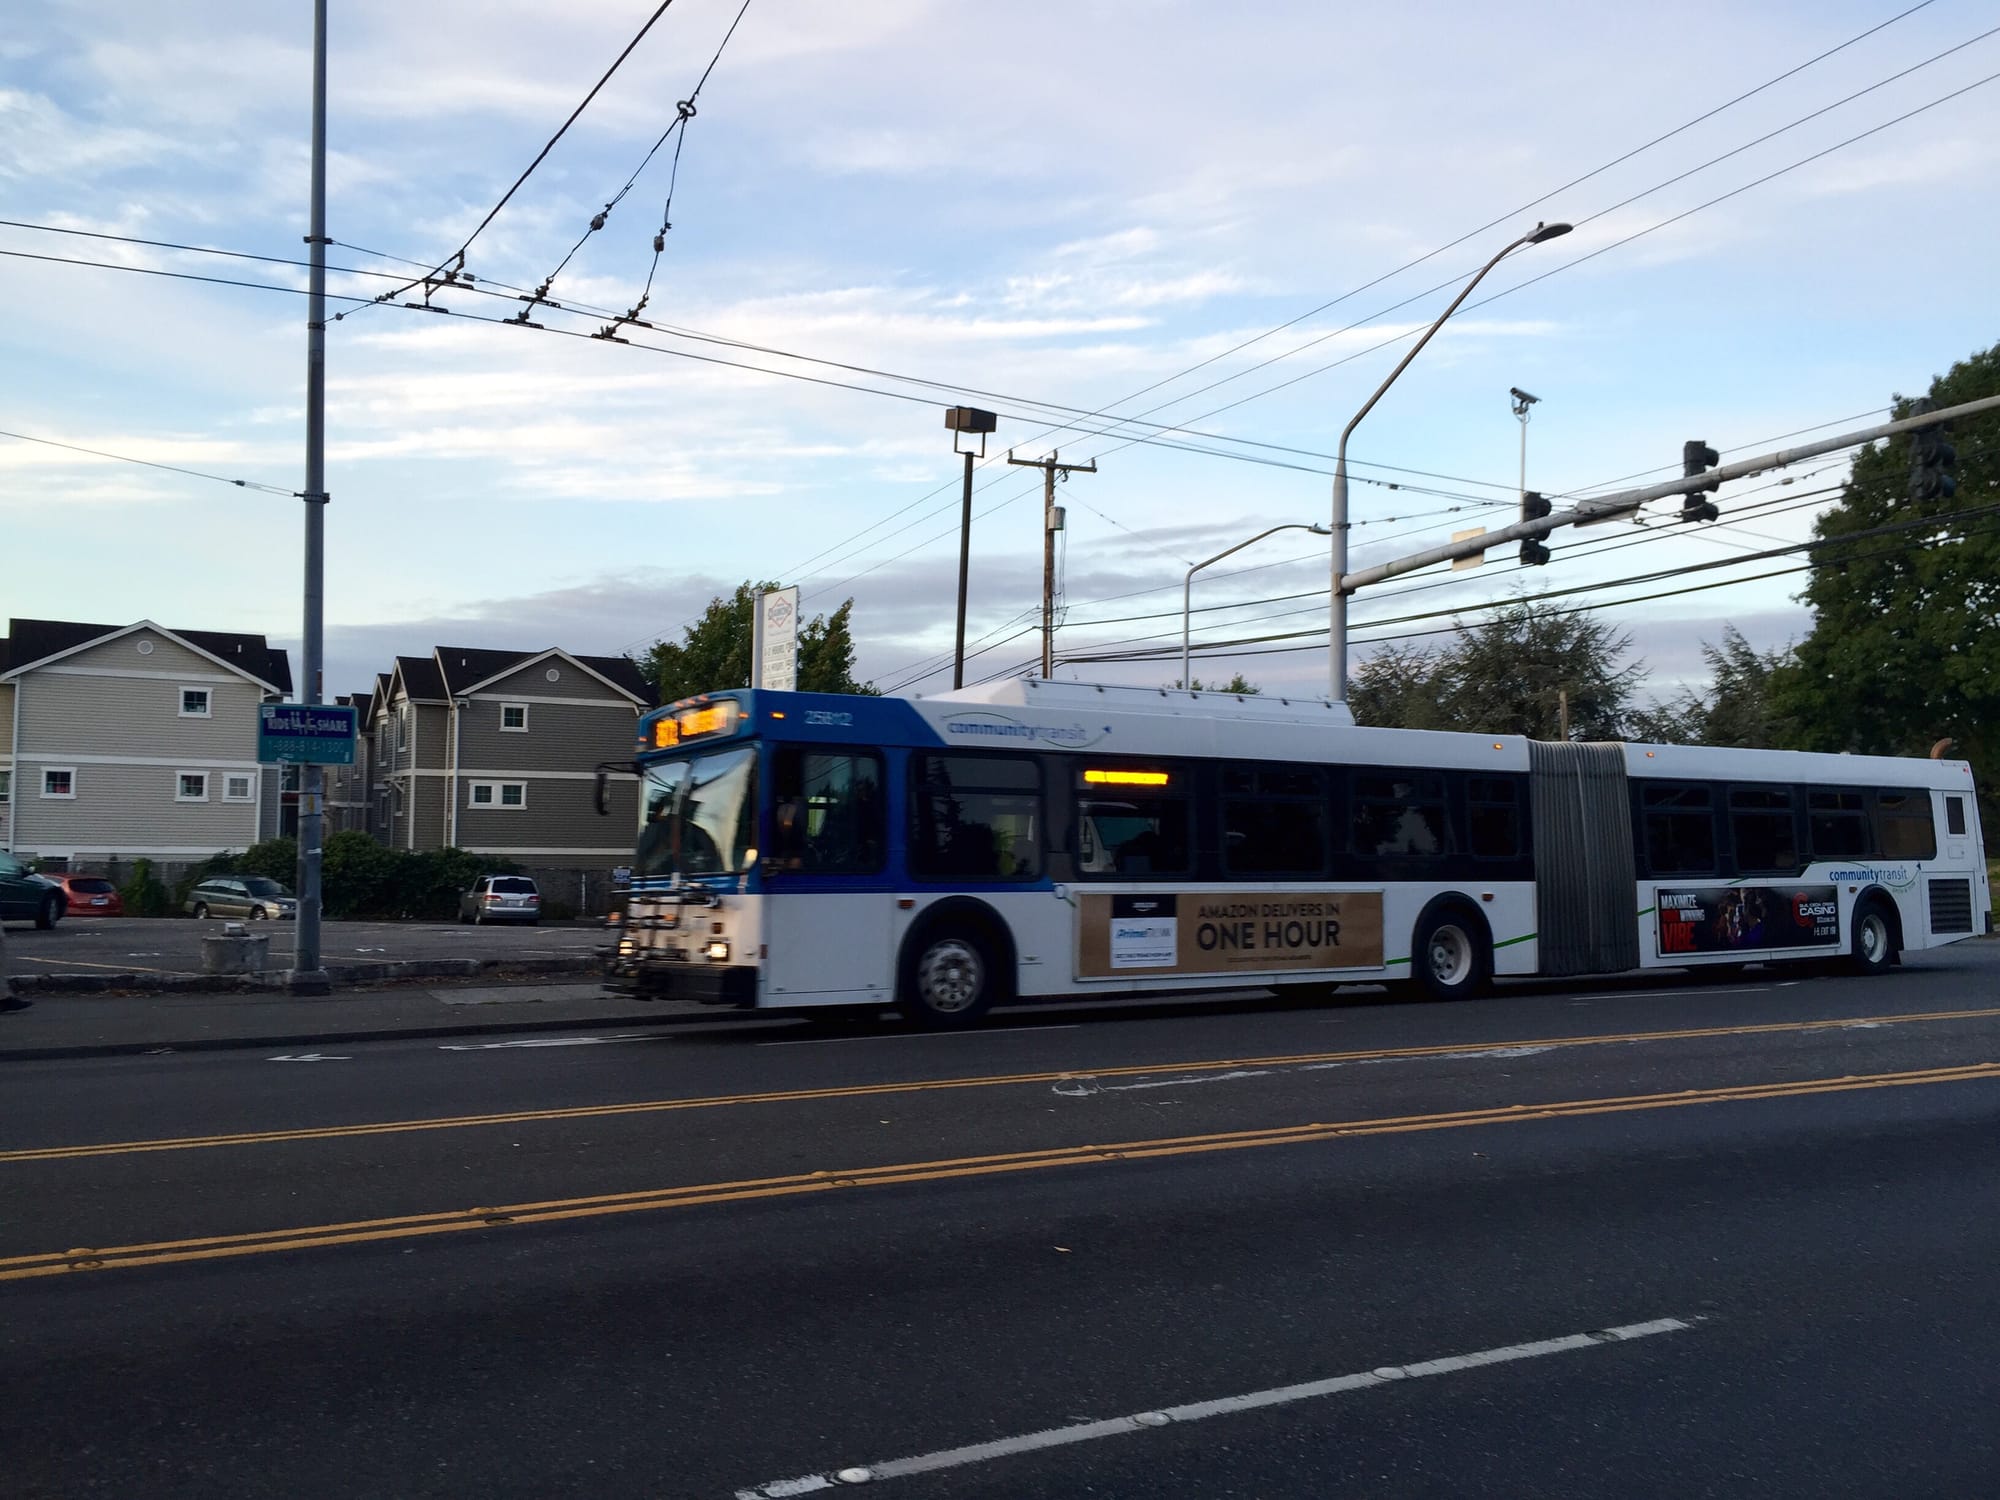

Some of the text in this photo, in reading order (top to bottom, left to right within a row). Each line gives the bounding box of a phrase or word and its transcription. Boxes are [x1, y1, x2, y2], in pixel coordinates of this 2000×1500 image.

[317, 719, 348, 732] SHARE
[1660, 894, 1698, 909] MAXIMIZE
[1199, 903, 1340, 918] AMAZON DELIVERS IN
[1799, 906, 1836, 917] CASINO
[1197, 920, 1340, 950] ONE HOUR
[1662, 922, 1697, 952] VIBE
